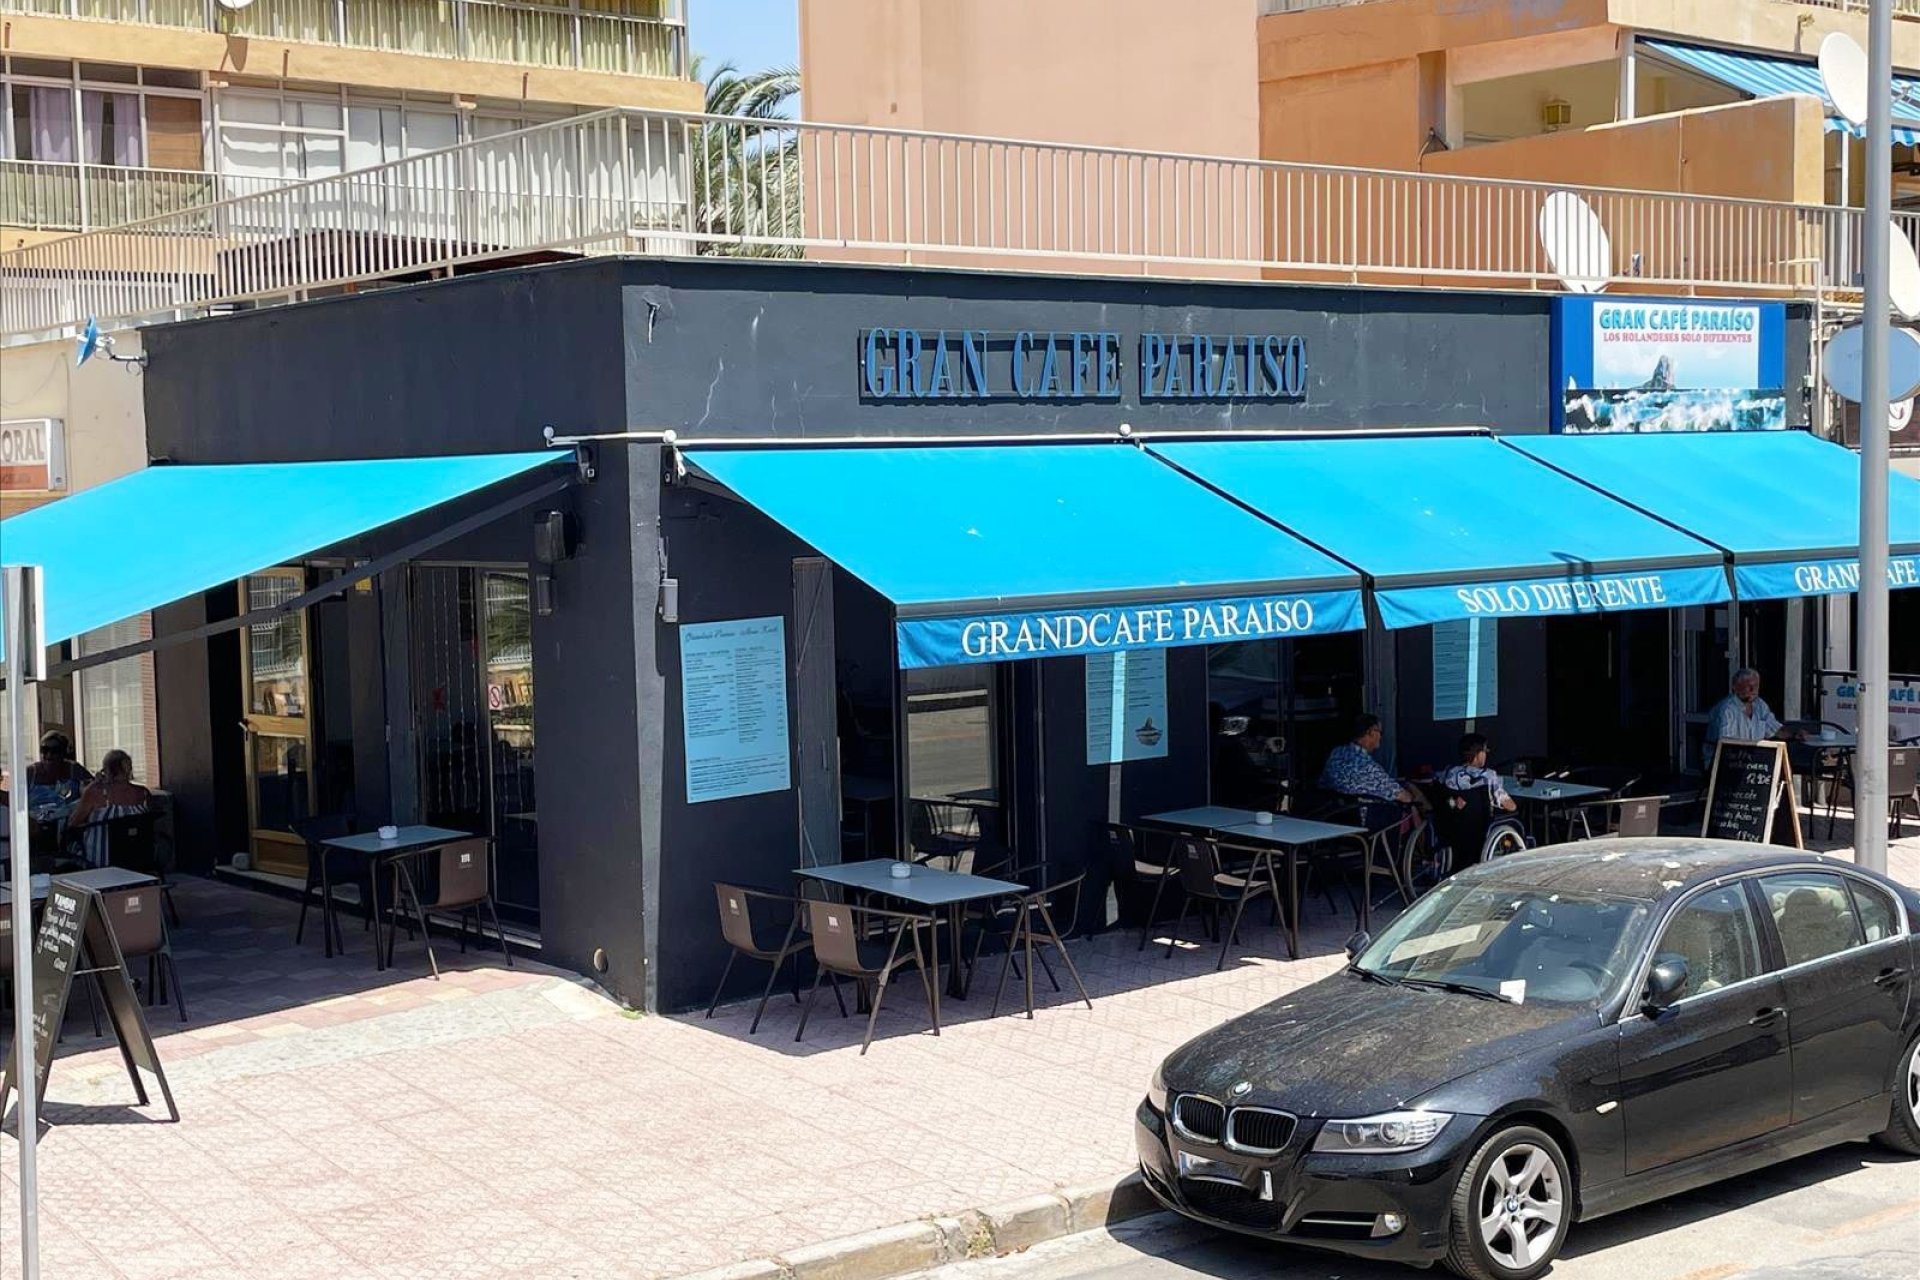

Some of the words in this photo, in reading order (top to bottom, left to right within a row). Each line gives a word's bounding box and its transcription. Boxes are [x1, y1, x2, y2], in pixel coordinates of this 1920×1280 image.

[1599, 308, 1646, 330] GRAN
[1649, 306, 1688, 331] CAFÉ
[1691, 307, 1755, 332] PARAÍSO
[1603, 332, 1621, 343] LOS
[1622, 332, 1680, 343] HOLANDESES
[1681, 333, 1702, 343] SOLO
[1703, 333, 1752, 344] DIFERENTES
[863, 327, 993, 398] GRAN
[1011, 331, 1122, 398] CAFE
[1141, 333, 1306, 397] PARAISO
[1457, 584, 1530, 614] SOLO
[1529, 575, 1667, 612] DIFERENTE
[961, 608, 1176, 657] GRANDCAFE
[1182, 599, 1314, 640] PARAISO
